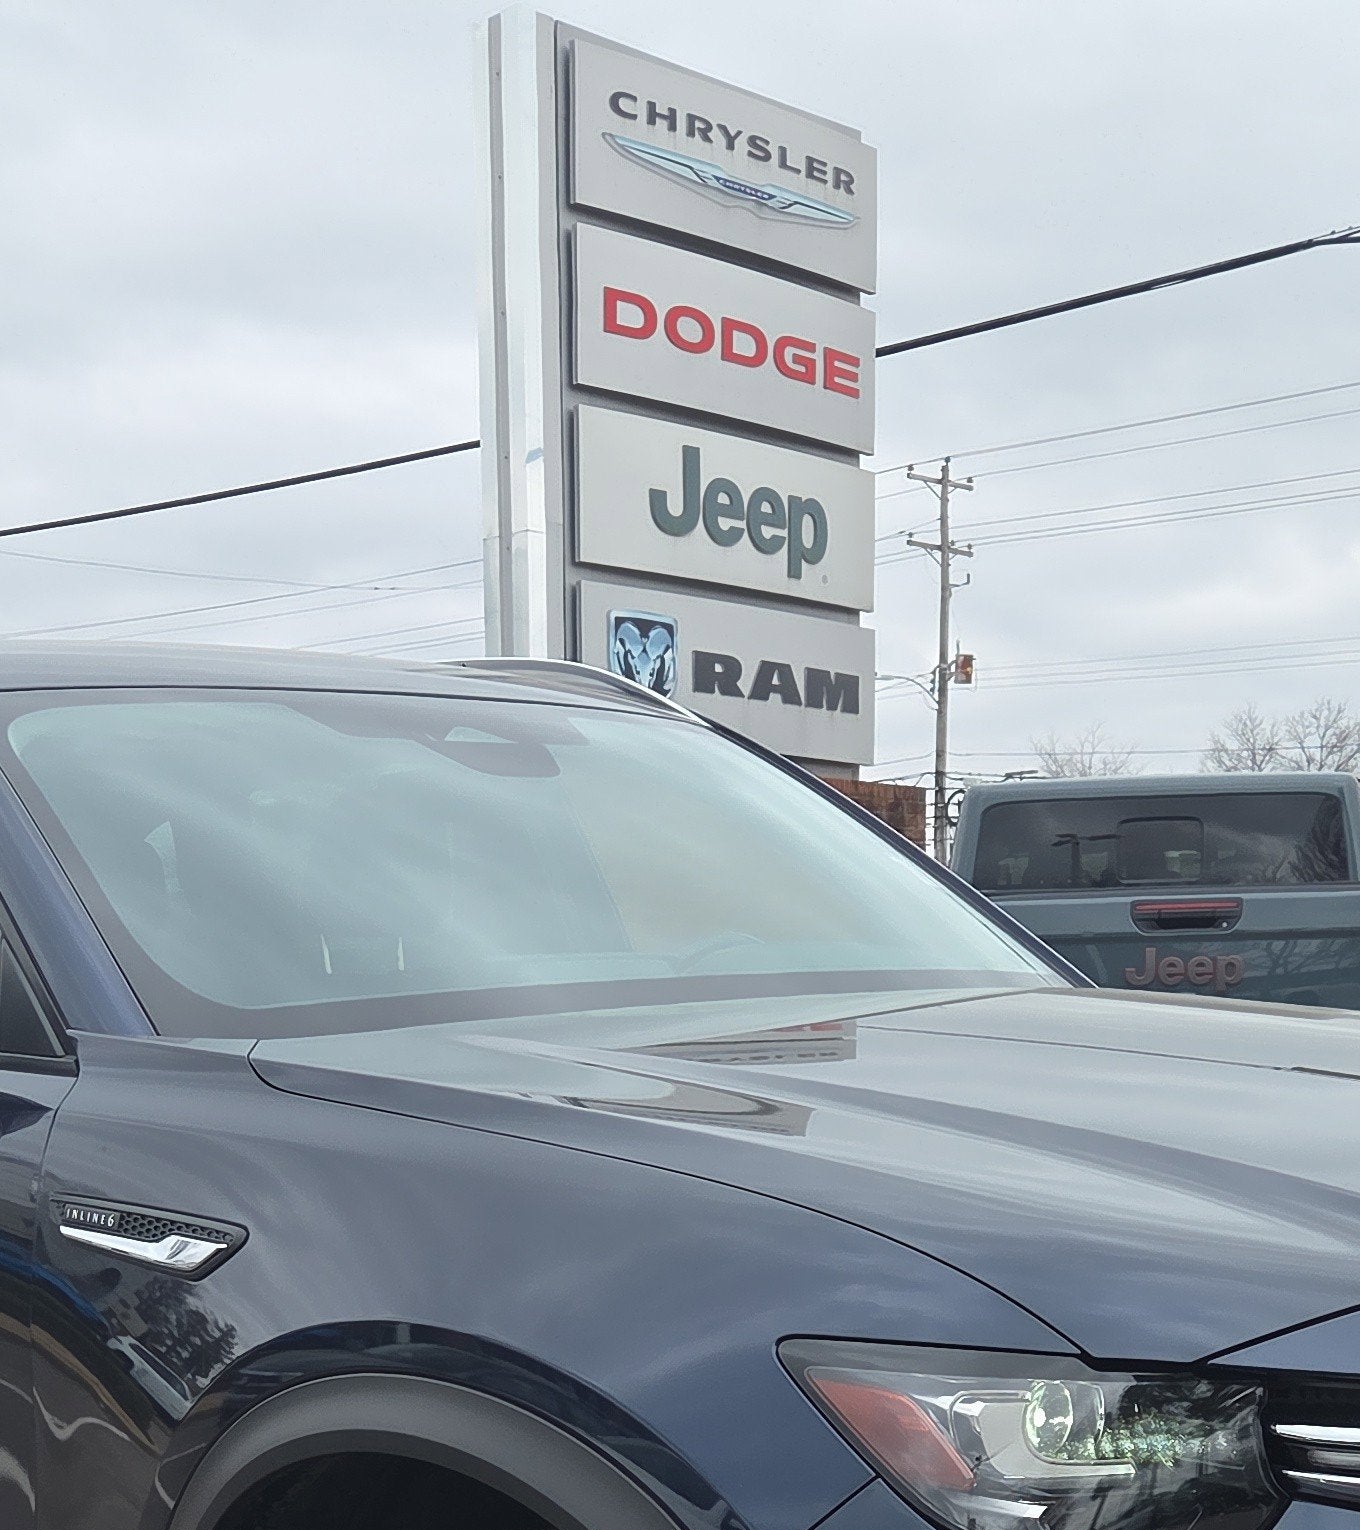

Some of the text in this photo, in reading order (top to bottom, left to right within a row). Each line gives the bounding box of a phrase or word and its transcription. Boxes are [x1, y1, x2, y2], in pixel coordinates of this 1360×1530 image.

[608, 90, 857, 197] CHRYSLER
[602, 286, 861, 400] DODGE
[648, 445, 829, 579] Jeep
[692, 649, 861, 716] RAM
[1124, 947, 1242, 992] Jeep
